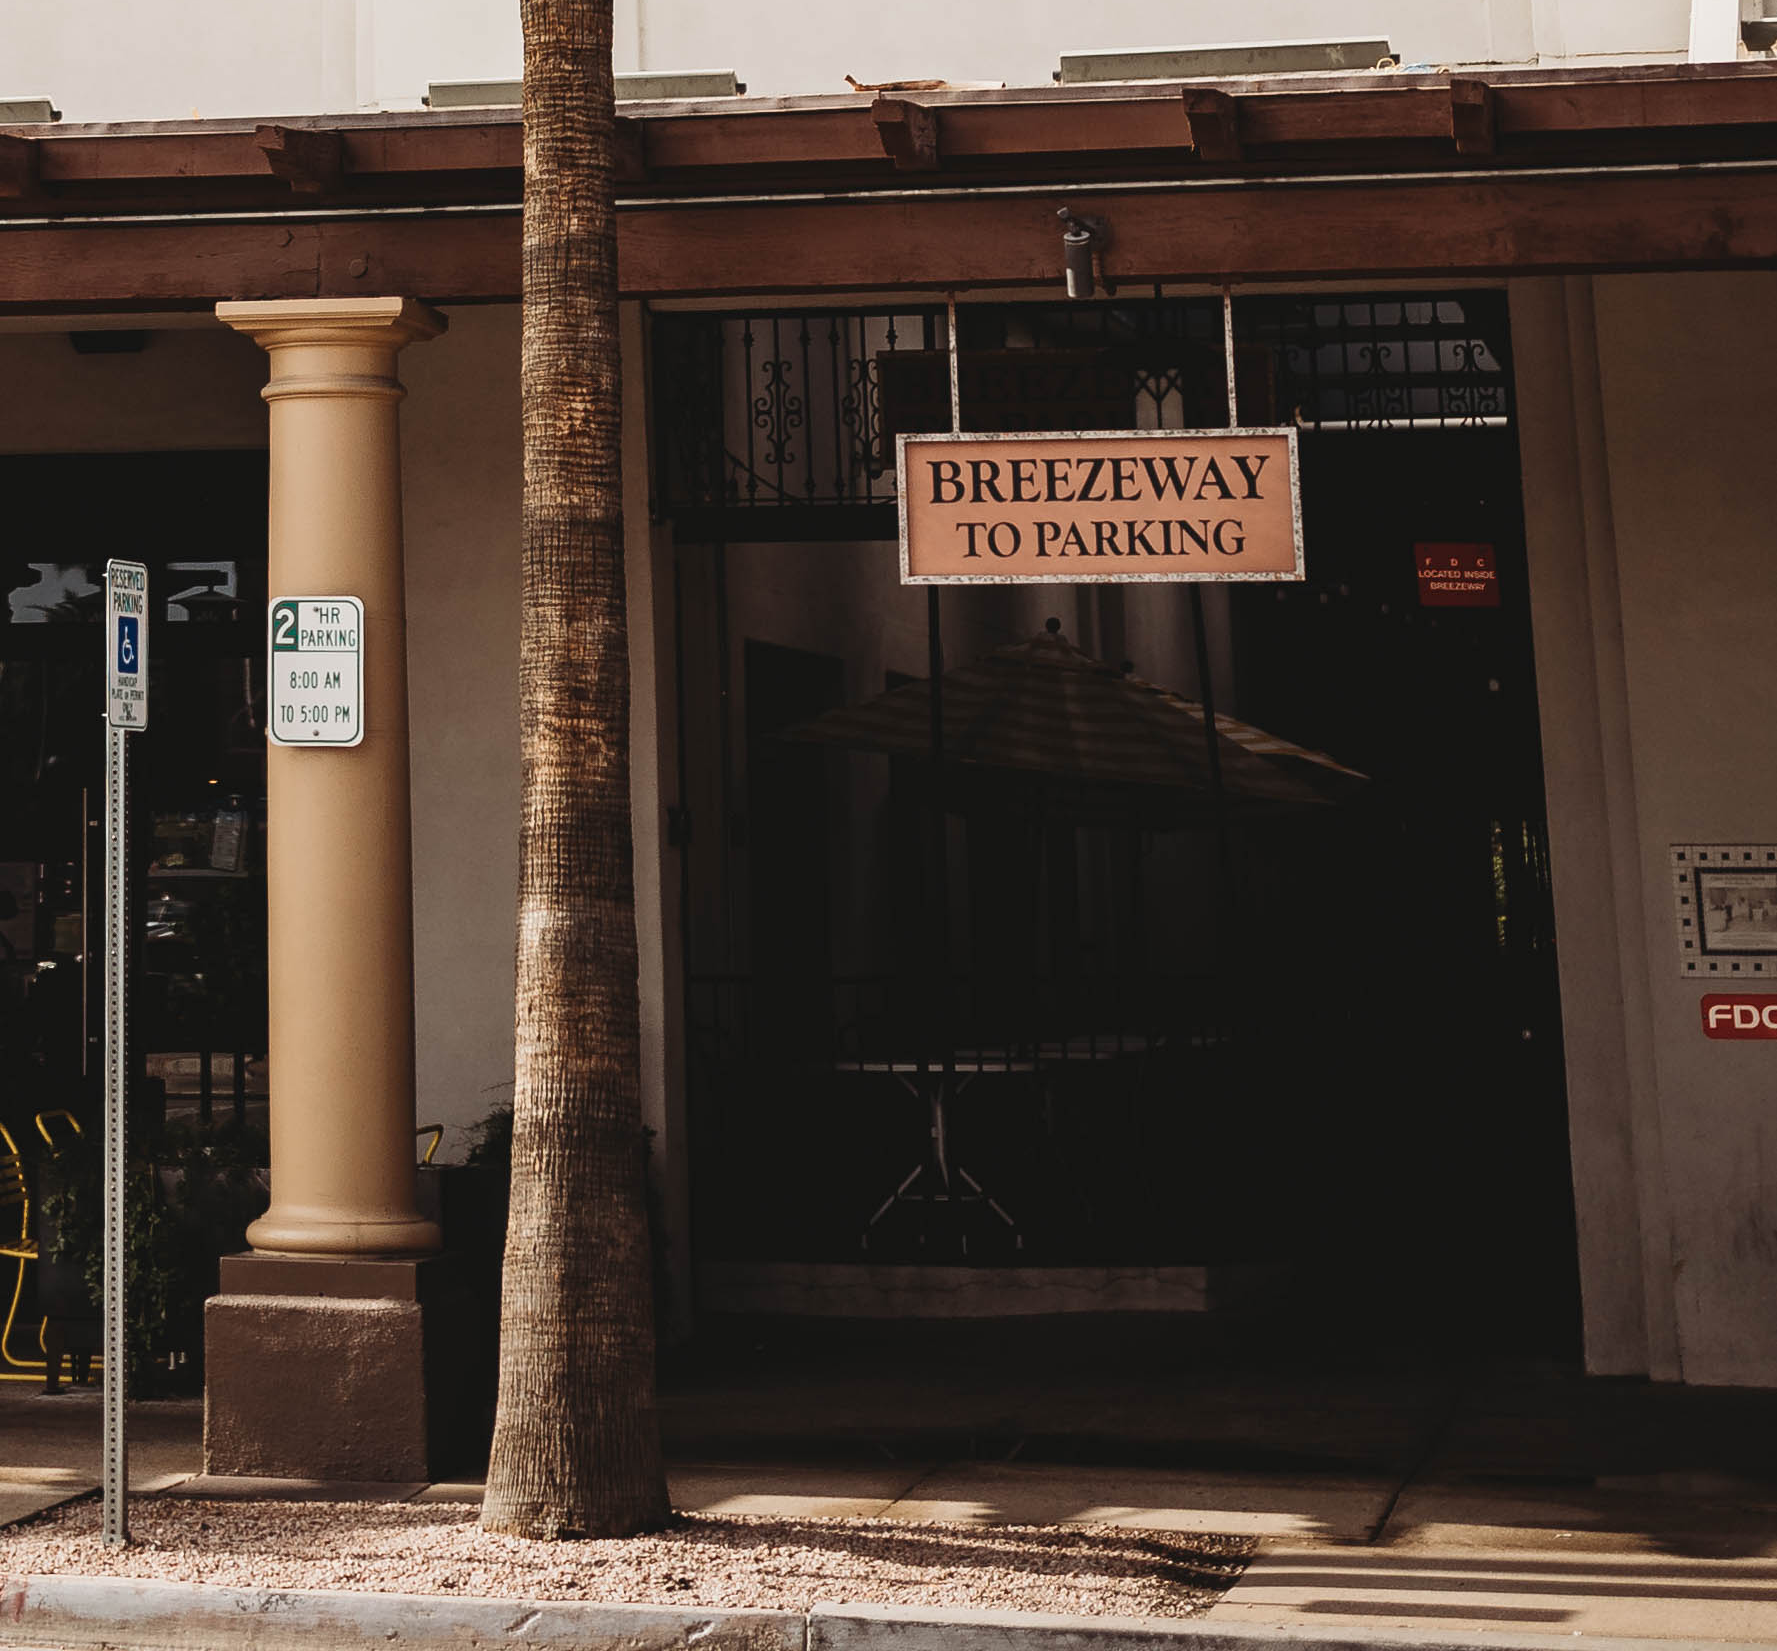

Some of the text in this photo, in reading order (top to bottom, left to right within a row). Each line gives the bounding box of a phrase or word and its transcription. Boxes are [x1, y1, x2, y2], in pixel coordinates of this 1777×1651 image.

[926, 454, 1270, 504] BREEZEWAY
[957, 518, 1246, 558] TO PARKING
[111, 568, 144, 591] RESERVED
[1418, 570, 1496, 579] LOCATED INSIDE
[1430, 581, 1486, 590] BREEZEWAY
[113, 591, 143, 614] PARKING
[275, 607, 341, 645] 2 HR
[301, 629, 356, 647] PARKING
[289, 671, 341, 689] 8:00 AM
[281, 705, 350, 723] TO 5:00 PM
